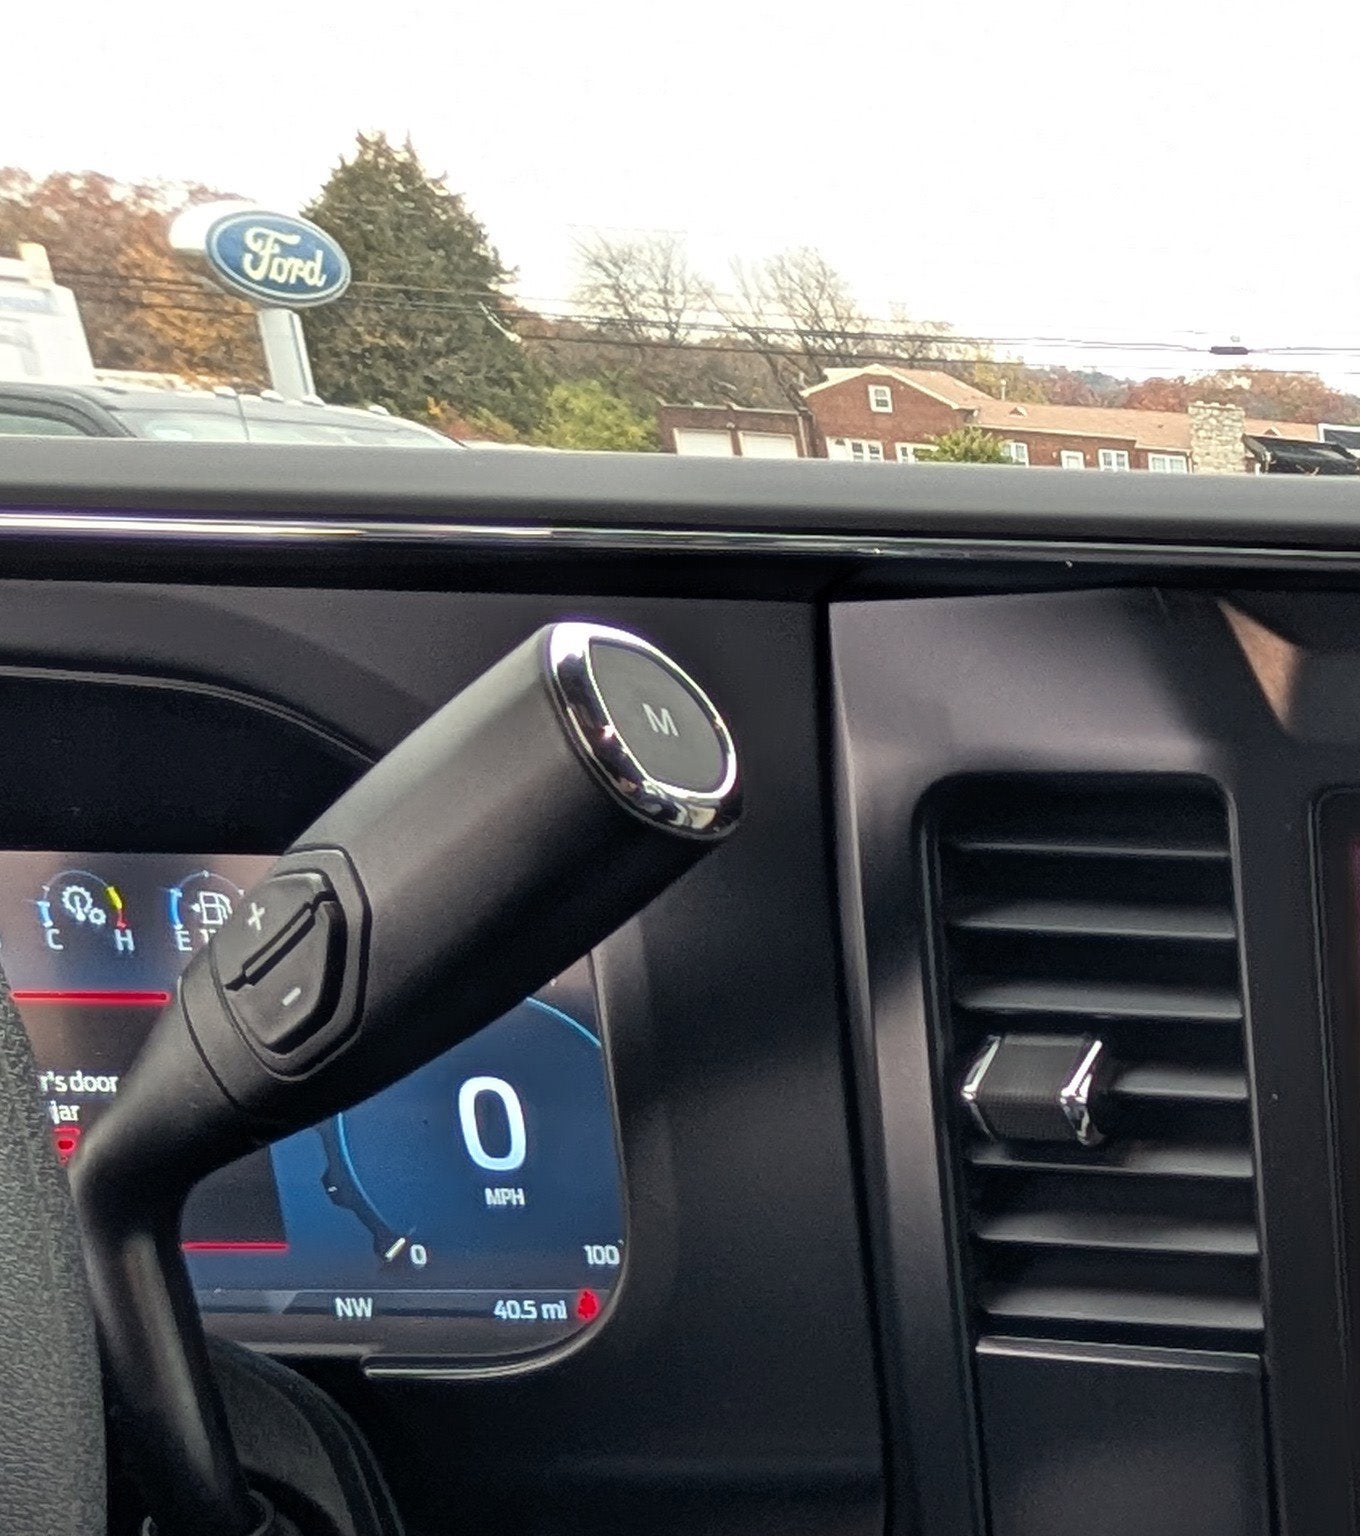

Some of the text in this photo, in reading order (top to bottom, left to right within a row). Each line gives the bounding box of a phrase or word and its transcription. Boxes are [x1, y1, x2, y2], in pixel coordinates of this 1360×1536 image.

[243, 226, 327, 287] Ford
[643, 703, 679, 737] M
[46, 928, 63, 950] C
[114, 929, 135, 950] H
[176, 930, 192, 951] E
[69, 1070, 118, 1092] door
[49, 1100, 79, 1124] jar
[457, 1075, 528, 1172] 0
[484, 1188, 526, 1206] MPH
[410, 1245, 427, 1265] 0
[584, 1245, 620, 1265] 100
[335, 1298, 373, 1318] NW
[493, 1300, 537, 1320] 40.5
